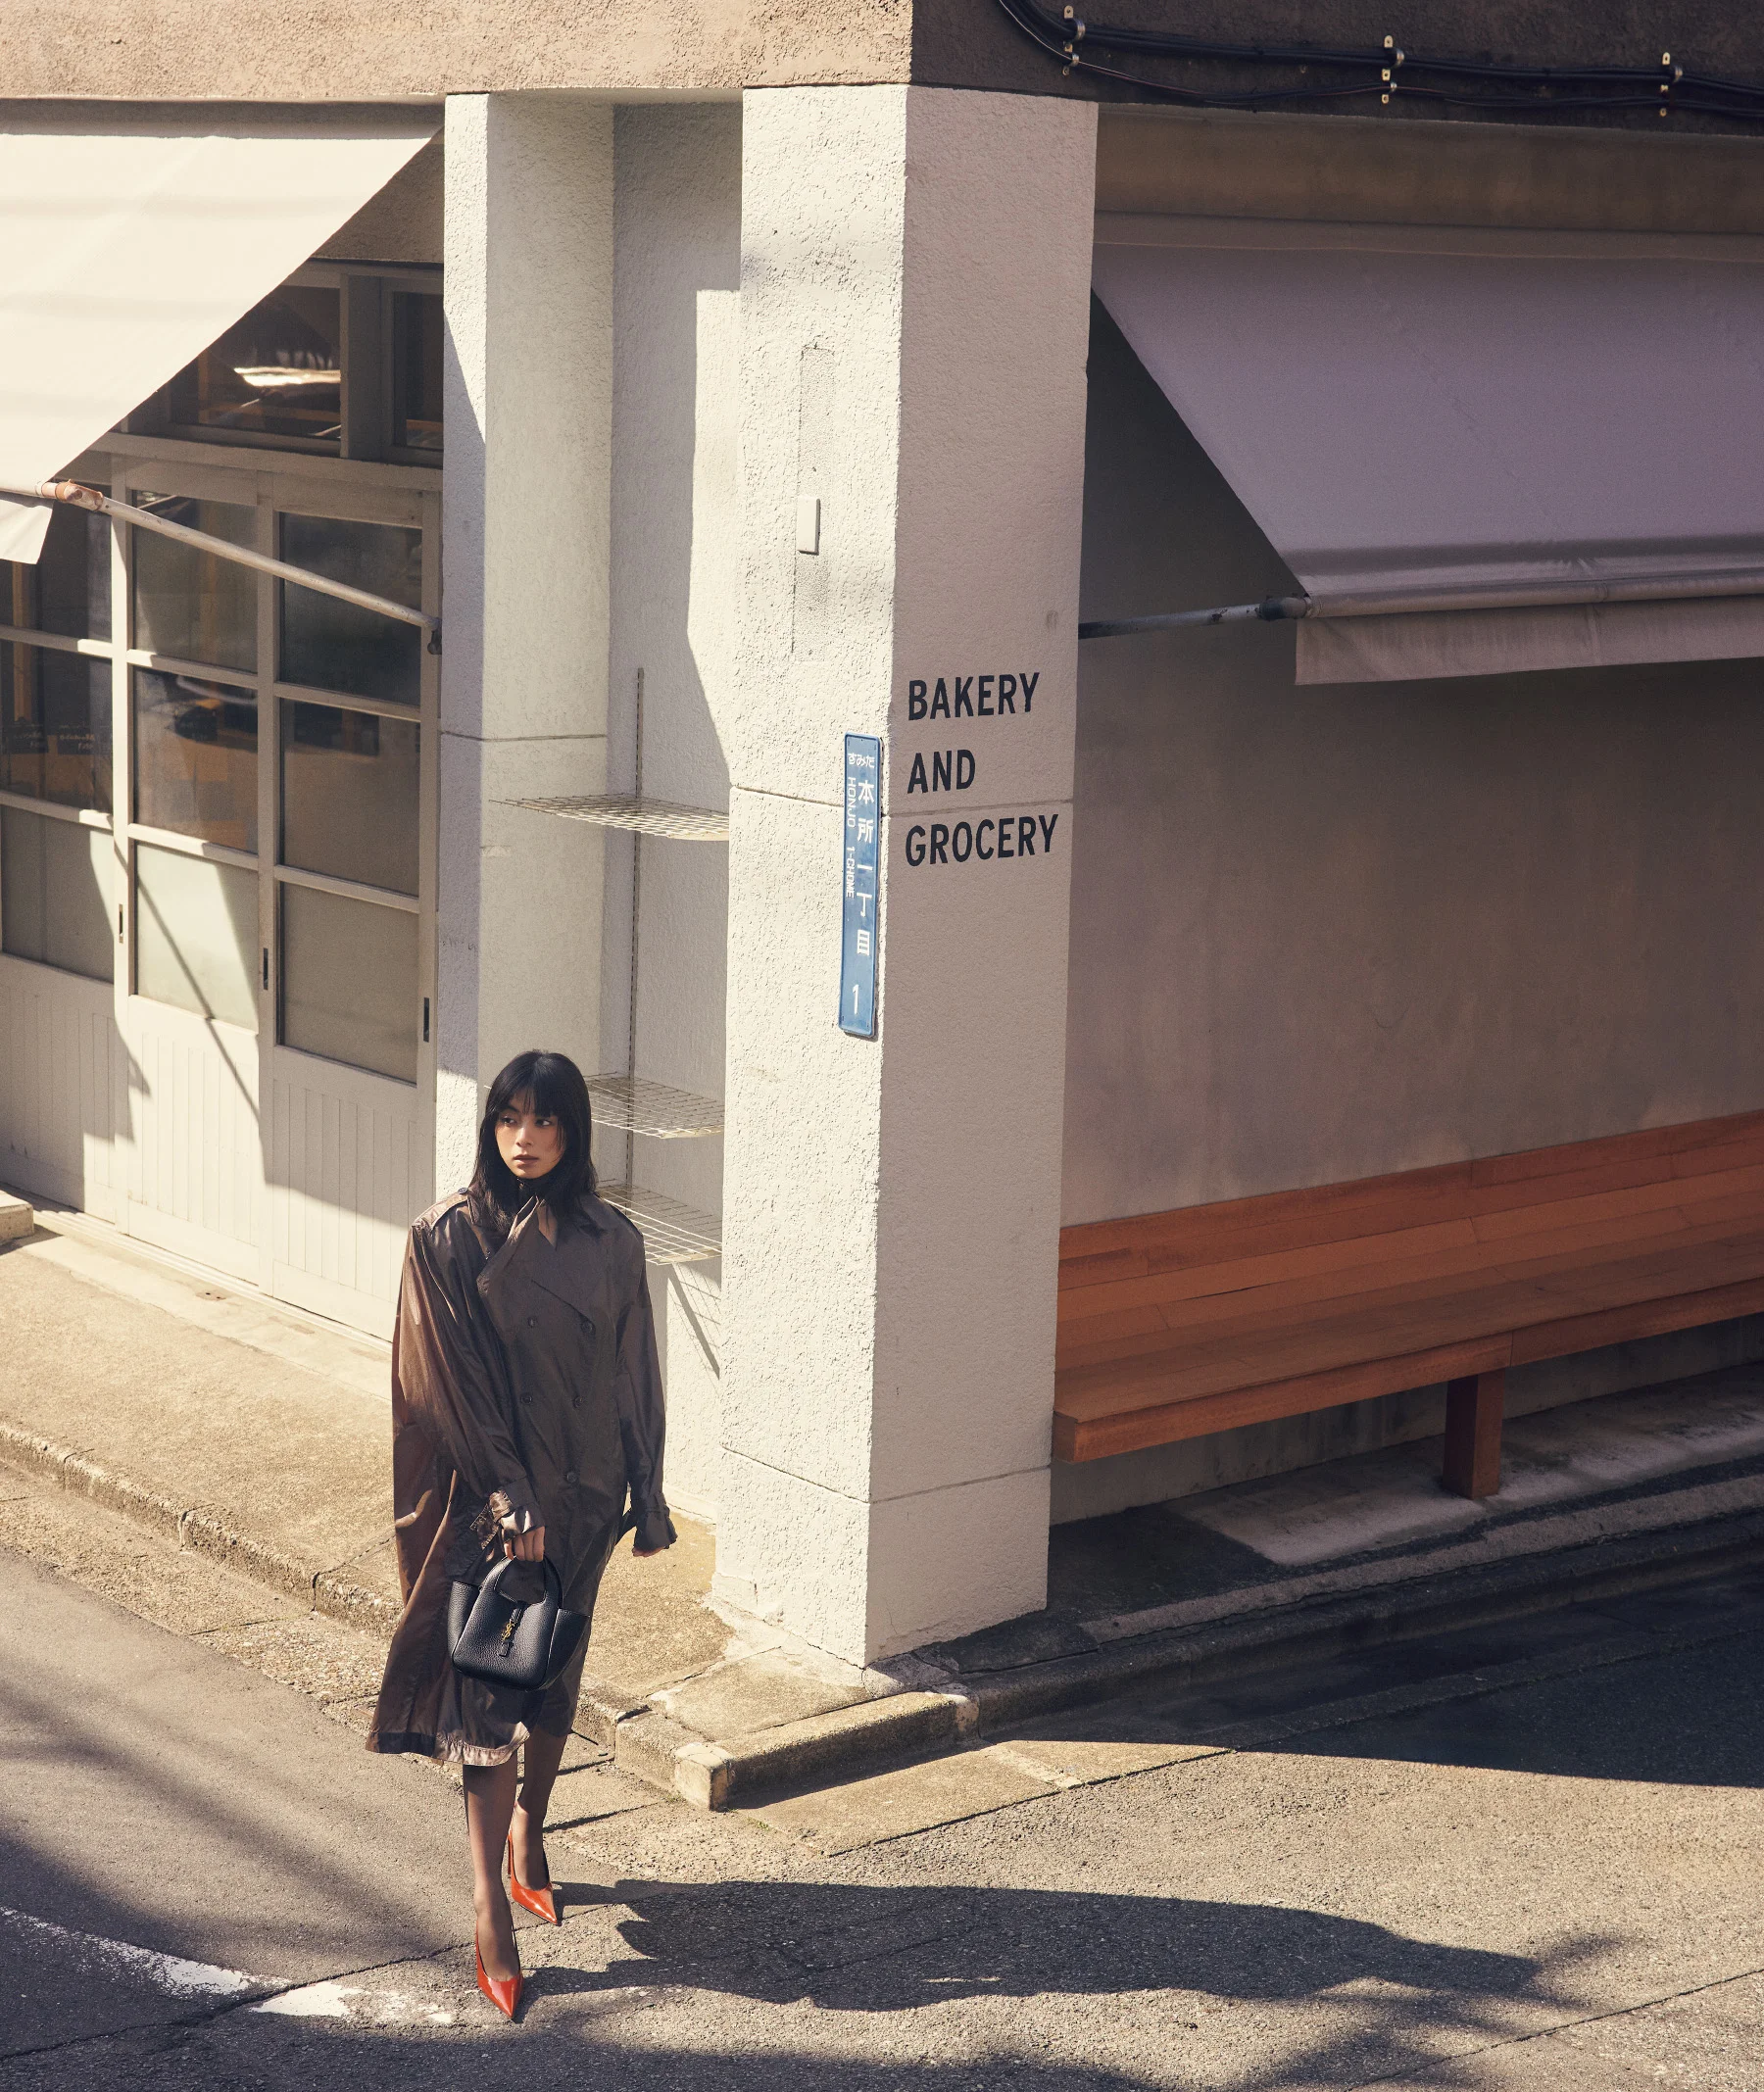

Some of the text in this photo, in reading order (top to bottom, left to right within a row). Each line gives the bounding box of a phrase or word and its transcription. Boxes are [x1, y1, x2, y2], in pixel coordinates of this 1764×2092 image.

[908, 672, 1040, 721] BAKERY
[848, 753, 875, 768] すみだ
[906, 749, 976, 794] AND
[846, 777, 857, 899] HONJO 1-CHOME
[906, 813, 1059, 867] GROCERY
[852, 779, 875, 1015] 本所一丁目 1
